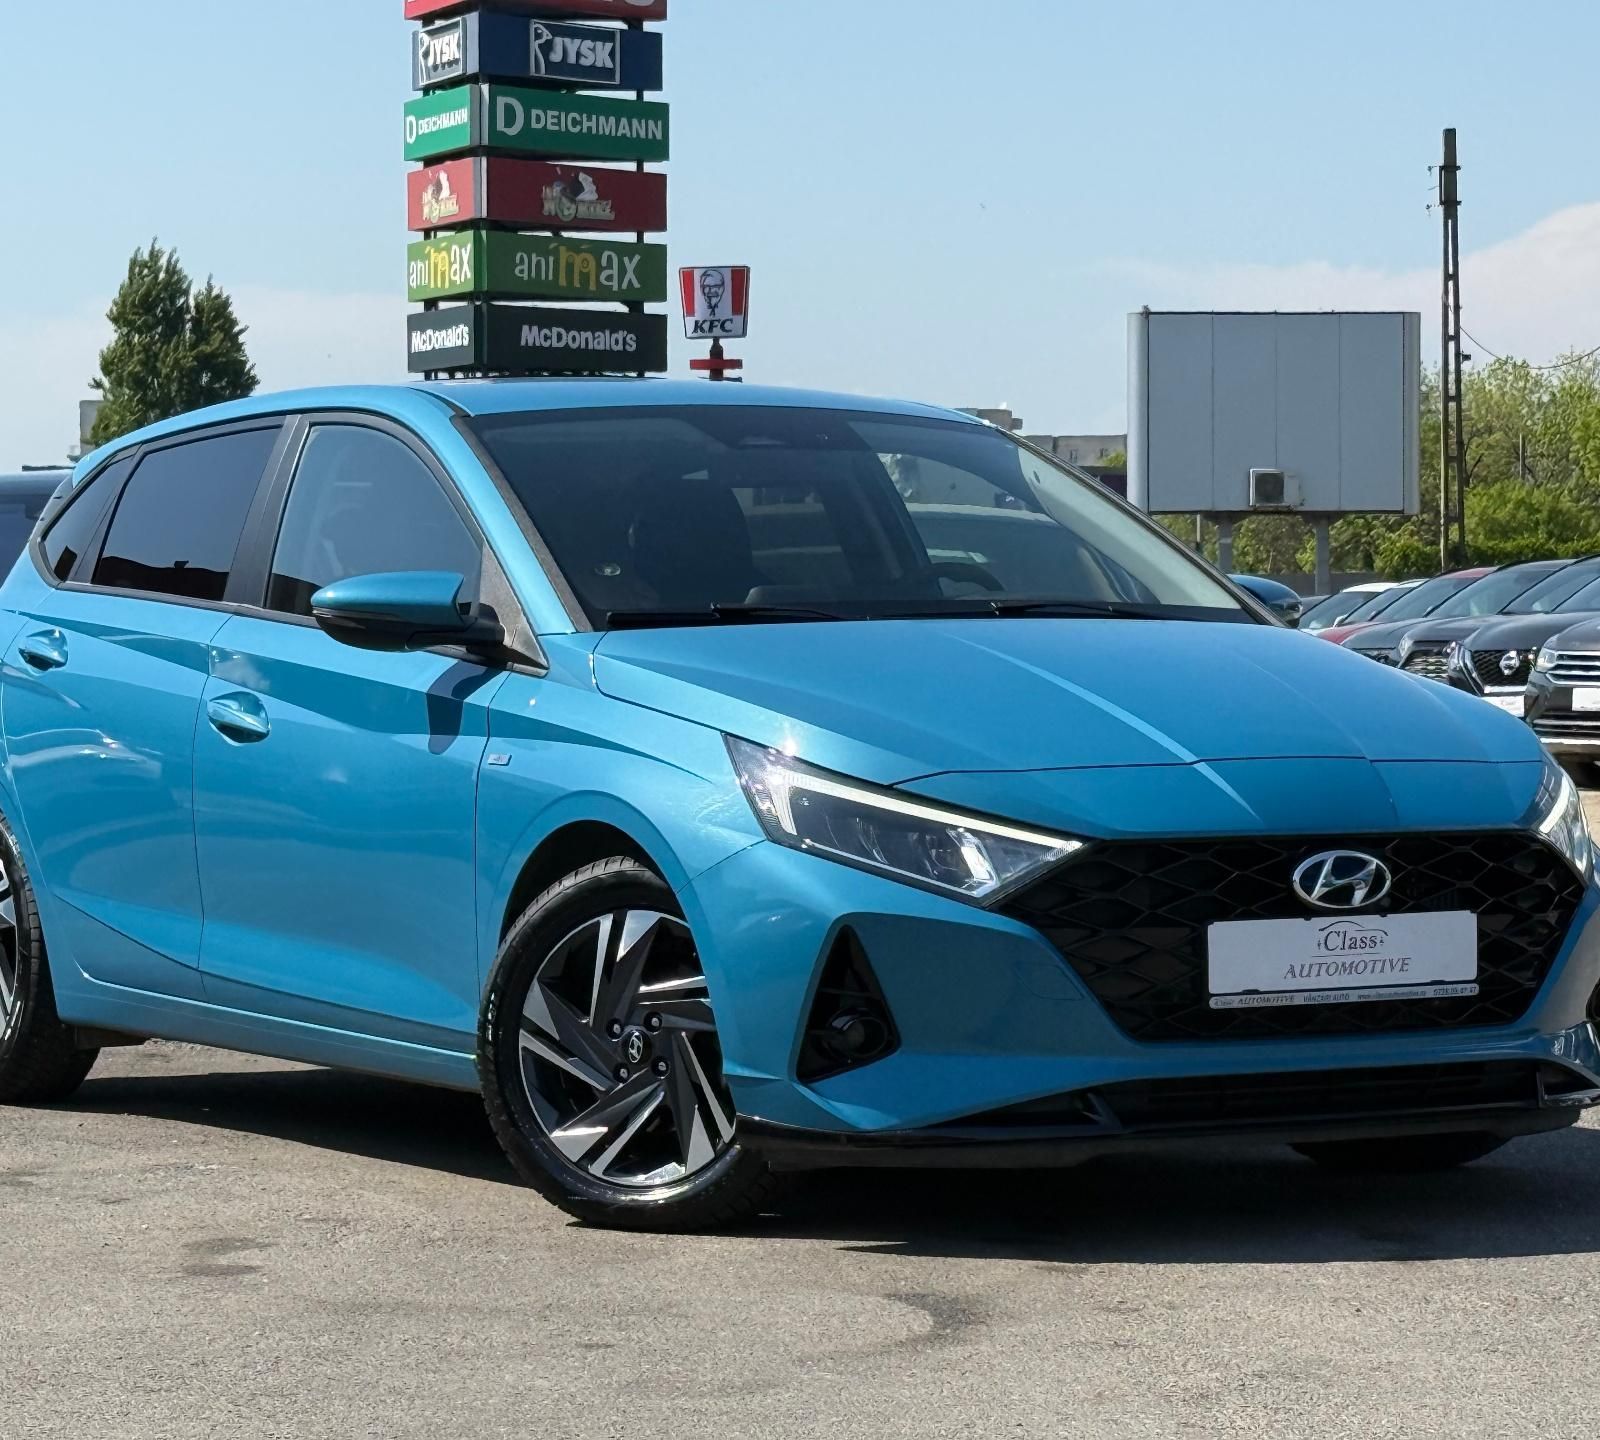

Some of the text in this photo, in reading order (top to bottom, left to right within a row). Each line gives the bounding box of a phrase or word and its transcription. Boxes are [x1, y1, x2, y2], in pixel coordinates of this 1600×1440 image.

[428, 32, 459, 66] JYSK
[549, 36, 615, 68] JYSK
[418, 107, 468, 136] DEICHMANN
[530, 108, 663, 140] DEICHMANN
[409, 242, 472, 289] animax
[515, 243, 641, 291] animax
[411, 323, 469, 353] McDonald's
[520, 324, 637, 352] McDonald's
[691, 318, 734, 335] KFC
[1324, 930, 1378, 951] Class
[1284, 957, 1412, 979] AUTOMOTIVE
